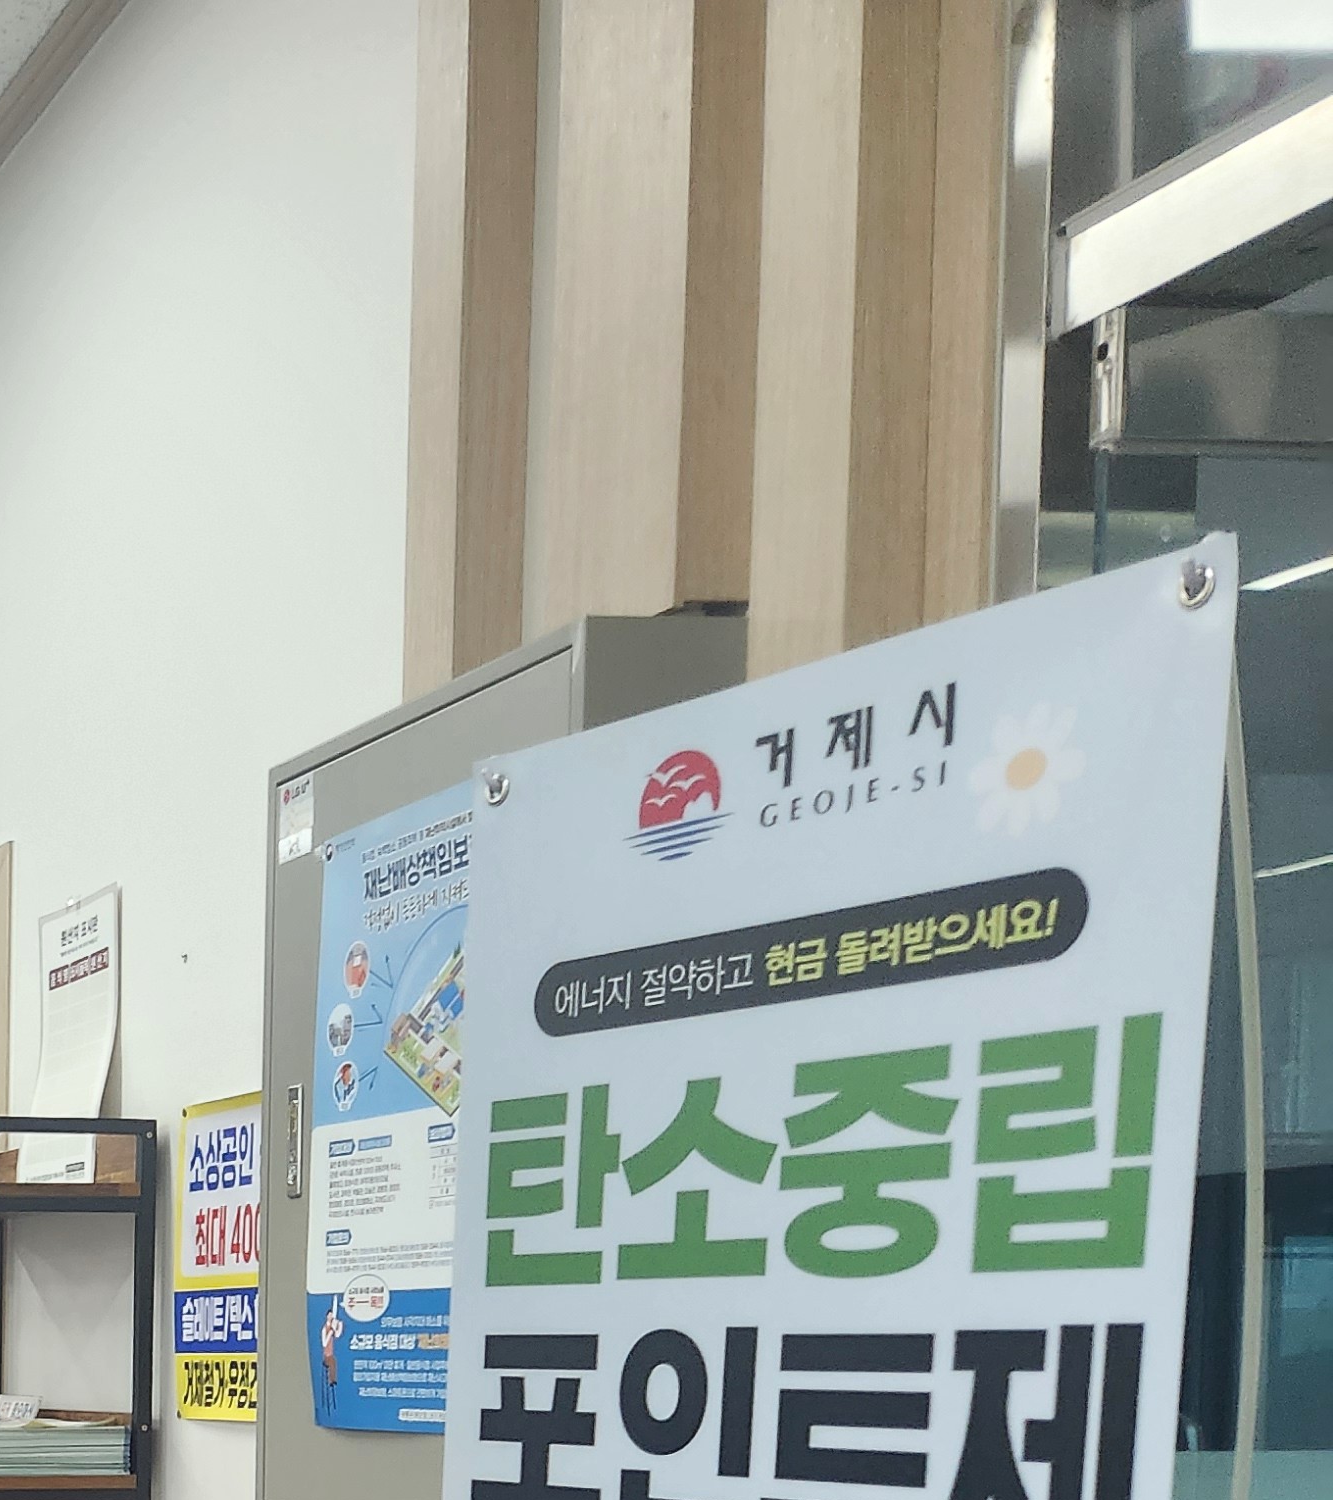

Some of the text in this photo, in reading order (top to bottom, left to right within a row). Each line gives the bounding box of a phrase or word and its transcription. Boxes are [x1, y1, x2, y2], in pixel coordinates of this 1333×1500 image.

[756, 681, 958, 791] 거제시
[761, 761, 949, 829] GEOJE-SI
[364, 834, 472, 899] 재난배상책임보
[554, 898, 1058, 1020] 에너지 절약하고 현금 돌려받으세요!
[189, 1122, 255, 1192] 소상공인
[485, 1011, 1163, 1288] 탄소중립
[195, 1205, 226, 1267] 최대
